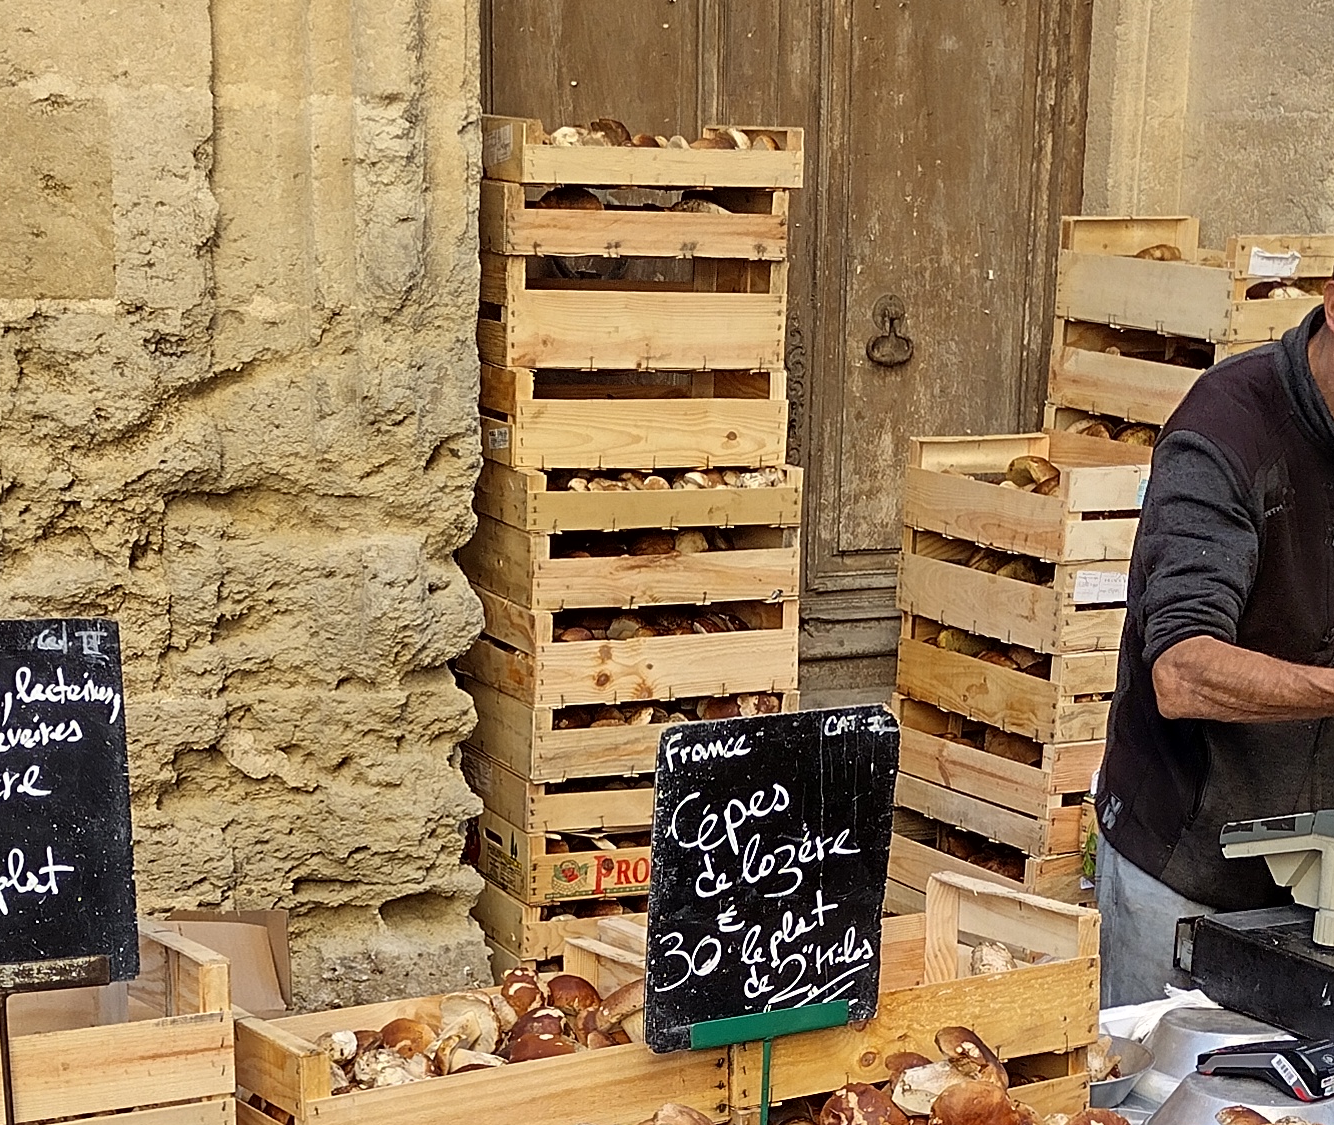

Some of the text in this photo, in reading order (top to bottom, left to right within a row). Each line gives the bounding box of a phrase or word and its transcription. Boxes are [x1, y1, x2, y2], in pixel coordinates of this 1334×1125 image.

[665, 732, 752, 773] France
[695, 852, 733, 898] de
[741, 924, 767, 965] le
[744, 965, 775, 999] de
